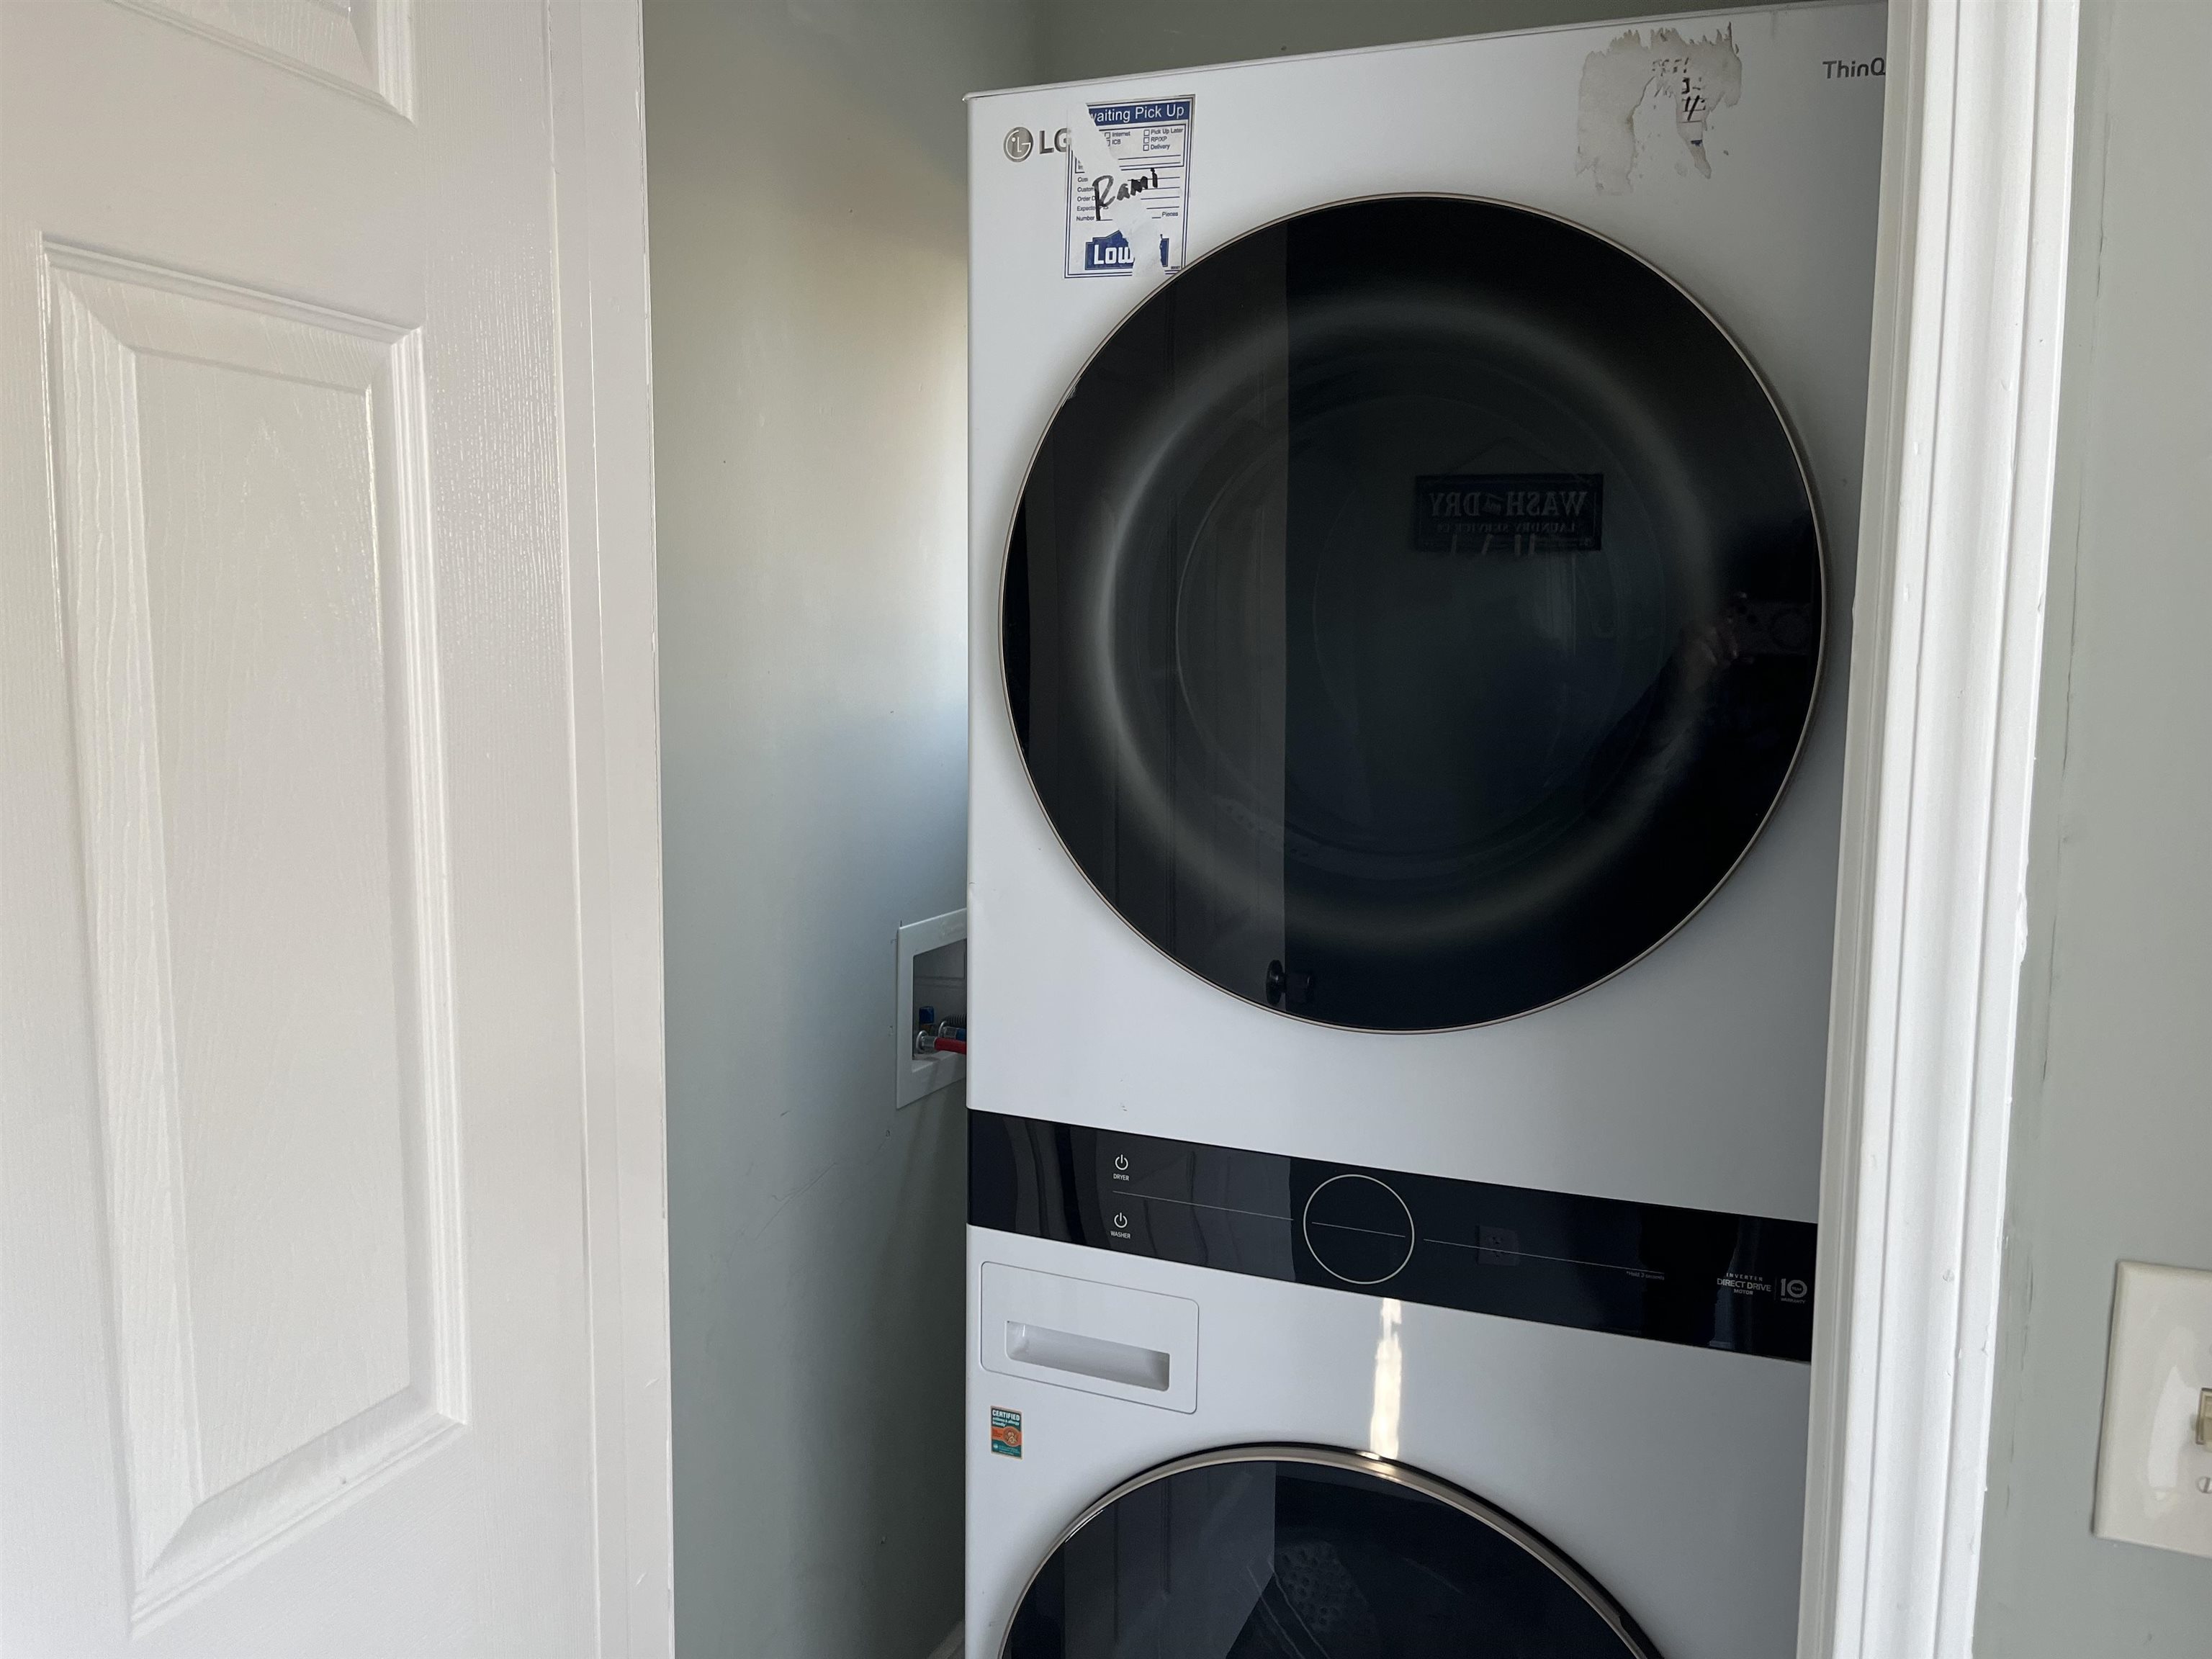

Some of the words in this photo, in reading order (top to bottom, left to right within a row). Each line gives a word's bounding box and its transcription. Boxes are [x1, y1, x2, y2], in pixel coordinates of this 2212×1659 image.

[1822, 57, 1886, 79] ThinQ
[1135, 104, 1162, 120] Pick
[1166, 104, 1184, 120] Up
[1039, 127, 1072, 155] LG
[1112, 1173, 1130, 1182] DRYER
[1110, 1230, 1131, 1239] WASHER
[1726, 1272, 1763, 1282] INVERTER
[1717, 1278, 1745, 1288] DIRECT
[1746, 1282, 1772, 1292] DRIVE
[1780, 1278, 1808, 1298] 10
[992, 1409, 1020, 1421] CERTIFIED
